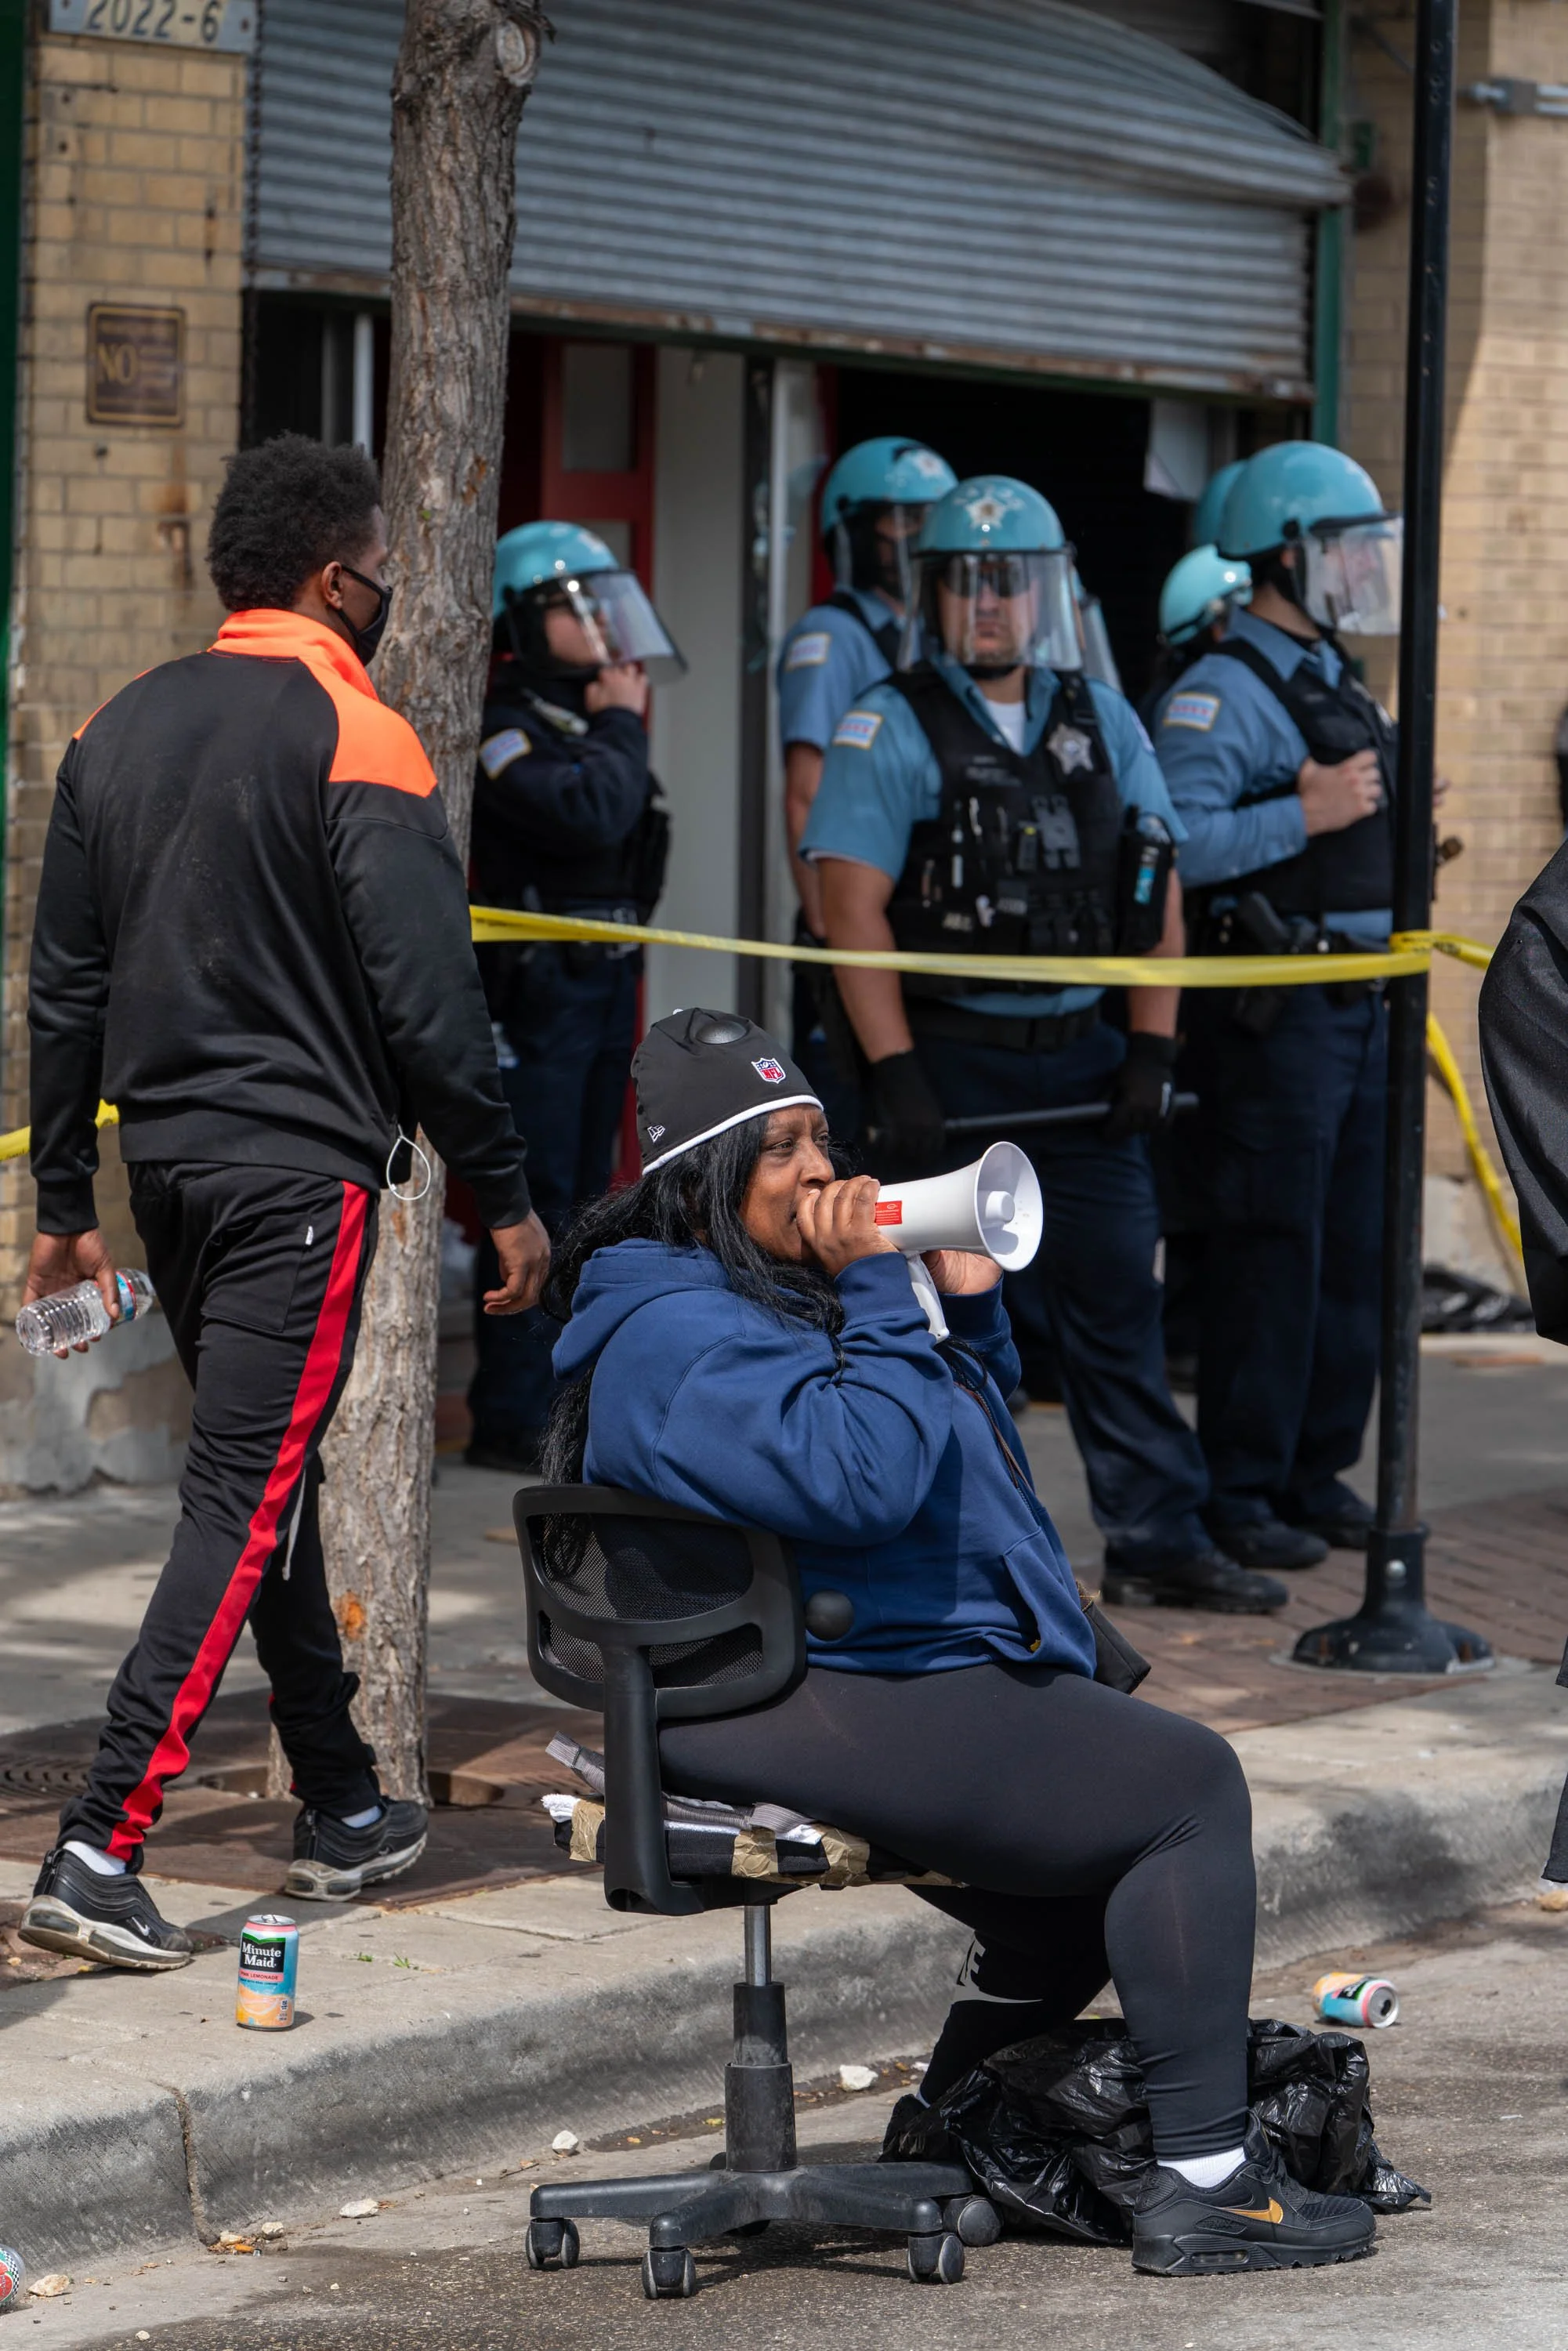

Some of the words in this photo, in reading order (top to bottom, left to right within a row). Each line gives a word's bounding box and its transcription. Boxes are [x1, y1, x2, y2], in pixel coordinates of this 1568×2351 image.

[86, 0, 222, 42] 2022-6
[97, 342, 138, 386] NO
[762, 1067, 782, 1079] NFL
[242, 1942, 281, 1958] Minute
[244, 1954, 275, 1968] Maid
